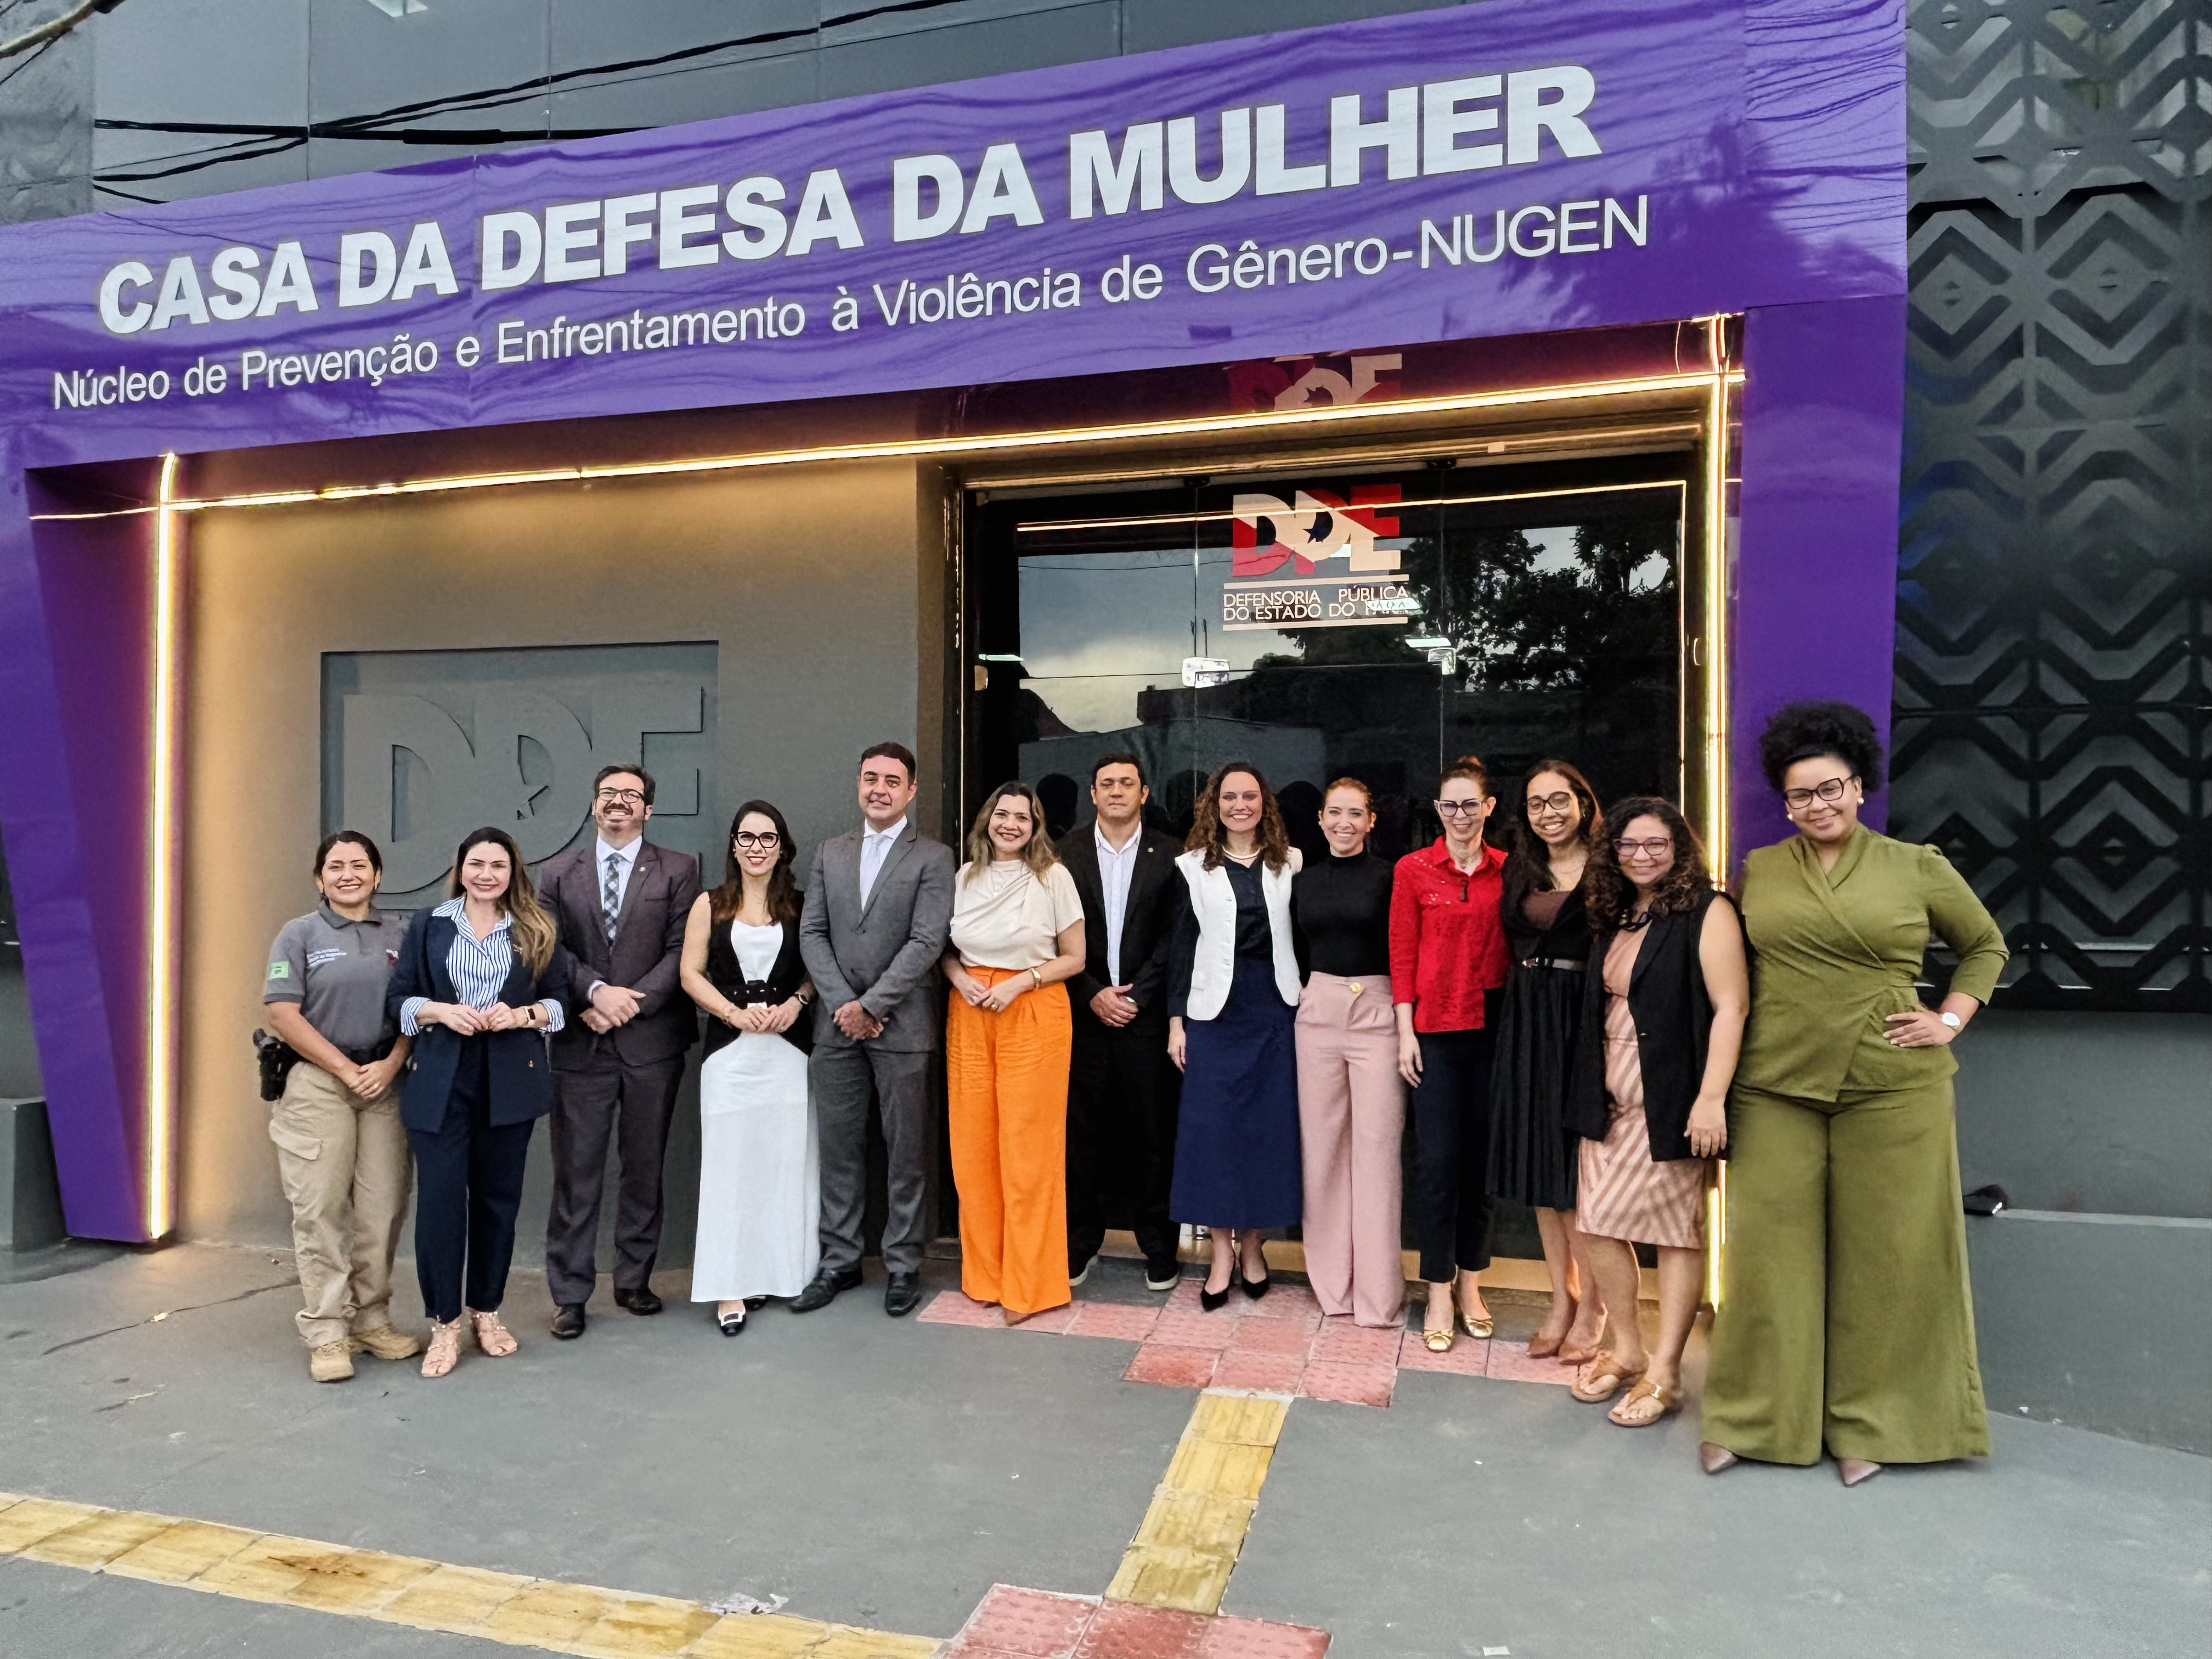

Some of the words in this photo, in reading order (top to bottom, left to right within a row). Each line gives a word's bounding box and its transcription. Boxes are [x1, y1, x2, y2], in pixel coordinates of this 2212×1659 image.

[99, 241, 319, 334] CASA
[338, 221, 459, 307] DA
[481, 168, 865, 291] DEFESA
[893, 143, 1045, 242] DA
[1070, 65, 1603, 219] MULHER
[54, 366, 170, 410] Núcleo
[184, 357, 227, 396] de
[242, 333, 438, 391] Prevenção
[456, 336, 481, 368] e
[498, 296, 805, 364] Enfrentamento
[832, 286, 859, 332] à
[873, 267, 1081, 326] Violência
[1101, 255, 1164, 303] de
[1187, 194, 1648, 294] Gênero-NUGEN
[1223, 590, 1321, 607] DEFENSORIA
[1338, 585, 1409, 603] PÚBLICA
[1223, 606, 1250, 621] DO
[1255, 603, 1322, 620] ESTADO
[1329, 602, 1356, 617] DO
